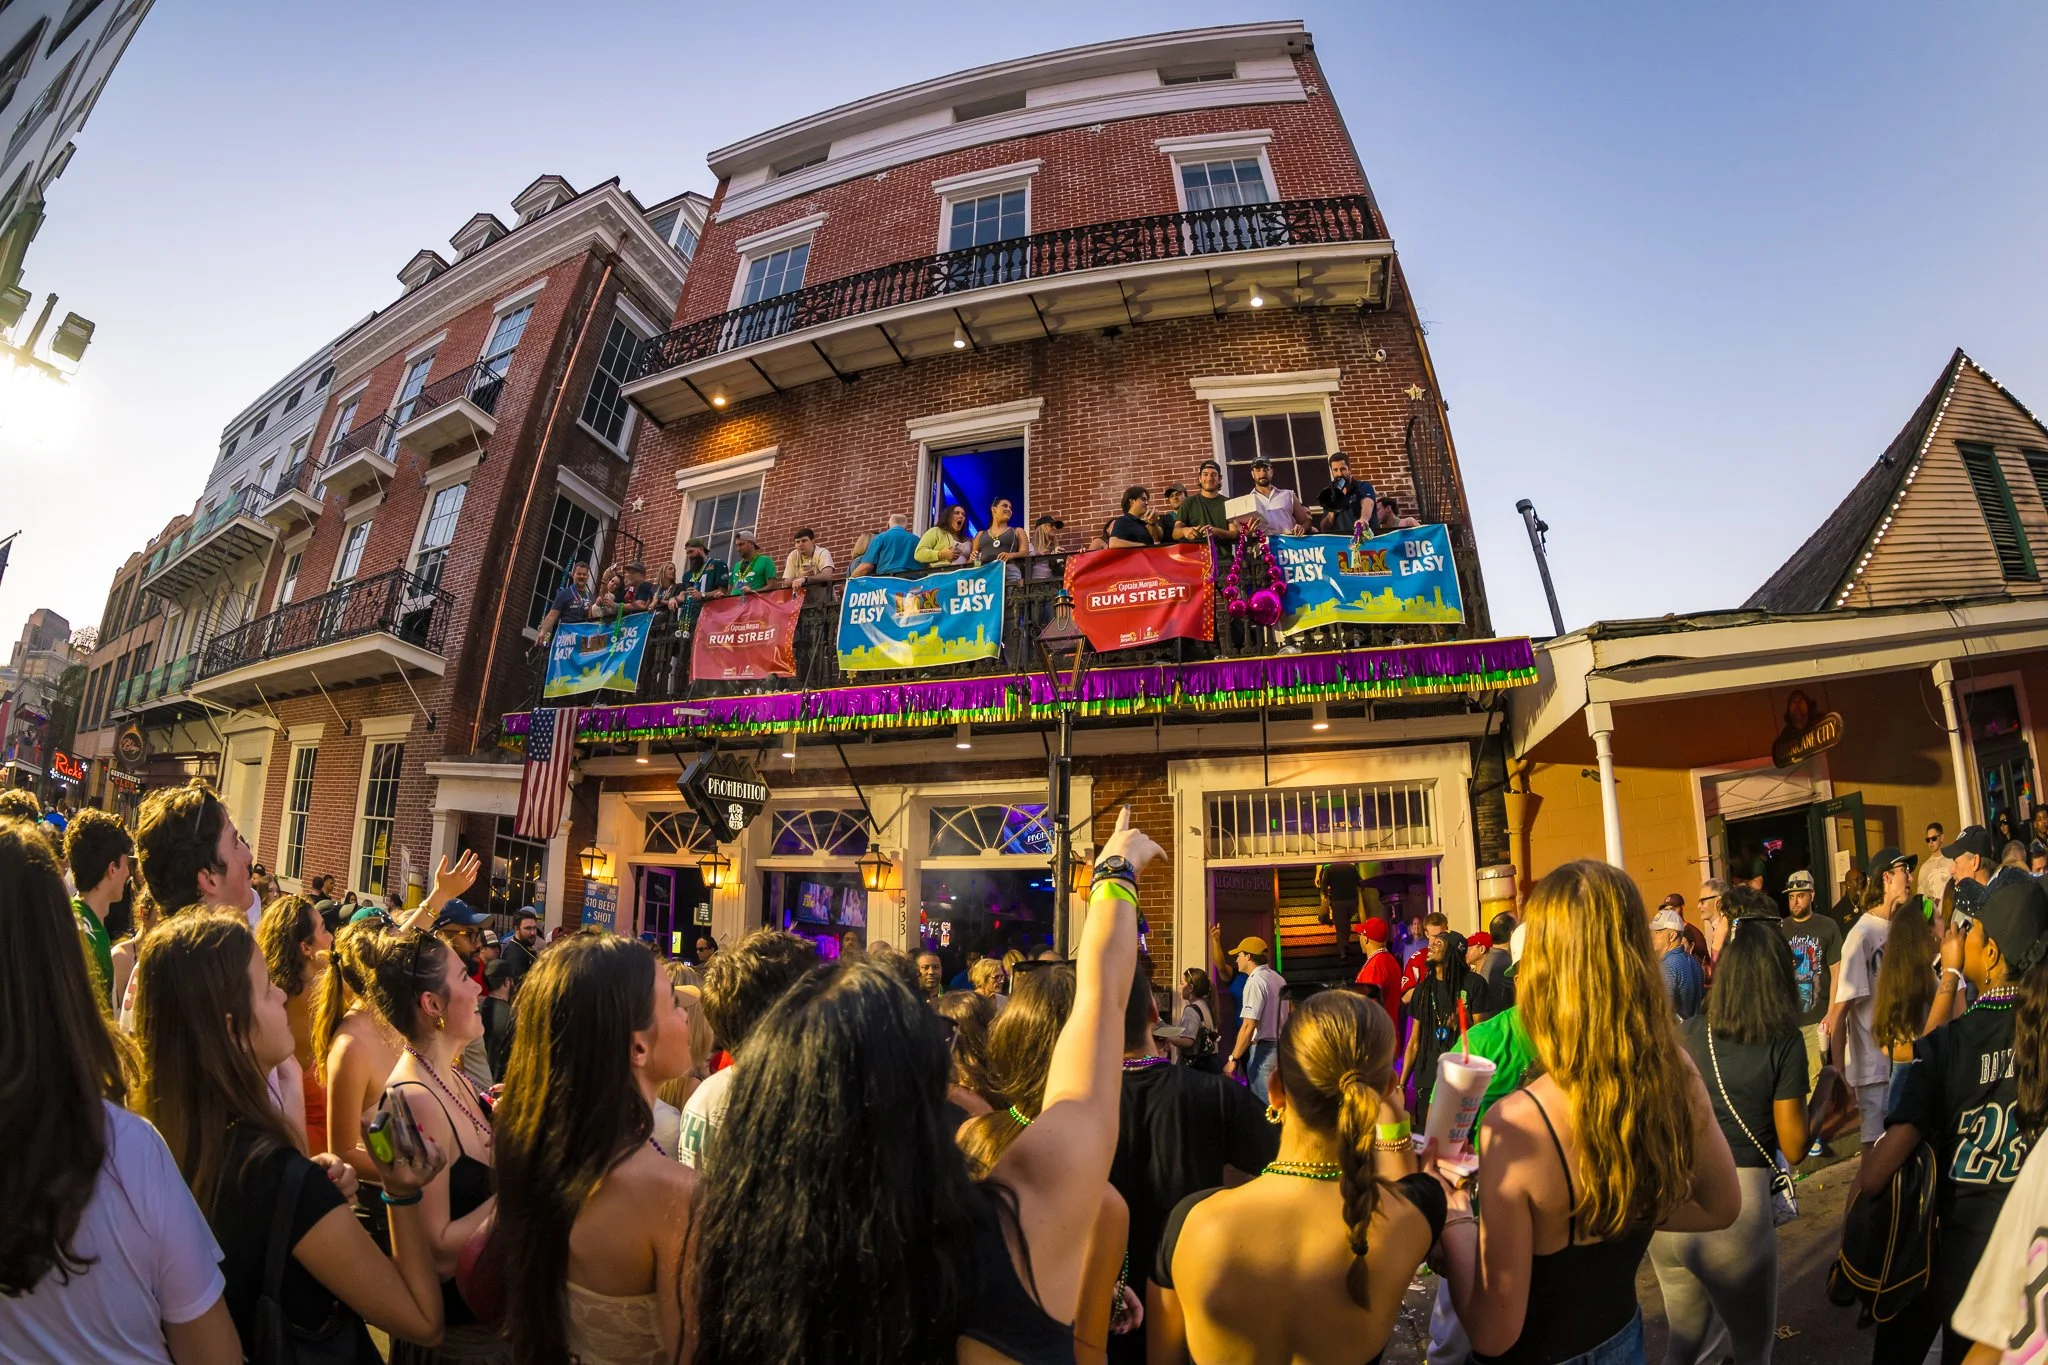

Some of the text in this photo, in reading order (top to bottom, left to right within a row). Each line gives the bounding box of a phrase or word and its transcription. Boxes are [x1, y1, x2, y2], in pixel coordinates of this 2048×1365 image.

[1277, 546, 1327, 566] DRINK
[1404, 540, 1435, 559] BIG
[1283, 564, 1324, 584] EASY
[1399, 555, 1444, 577] EASY
[957, 578, 987, 597] BIG
[1118, 580, 1159, 592] Captain Morgan
[849, 588, 889, 608] DRINK
[949, 593, 995, 615] EASY
[1091, 586, 1186, 608] RUM STREET
[849, 606, 885, 625] EASY
[709, 628, 776, 645] RUM STREET
[1816, 720, 1838, 744] CITY
[55, 751, 83, 780] Rick's
[110, 769, 141, 784] GENTLEMEN'S
[708, 777, 766, 801] PROHIBITION
[728, 803, 744, 814] HUGE
[729, 813, 743, 821] ASS
[585, 897, 616, 912] $10 BEER
[586, 910, 612, 923] + SHOT
